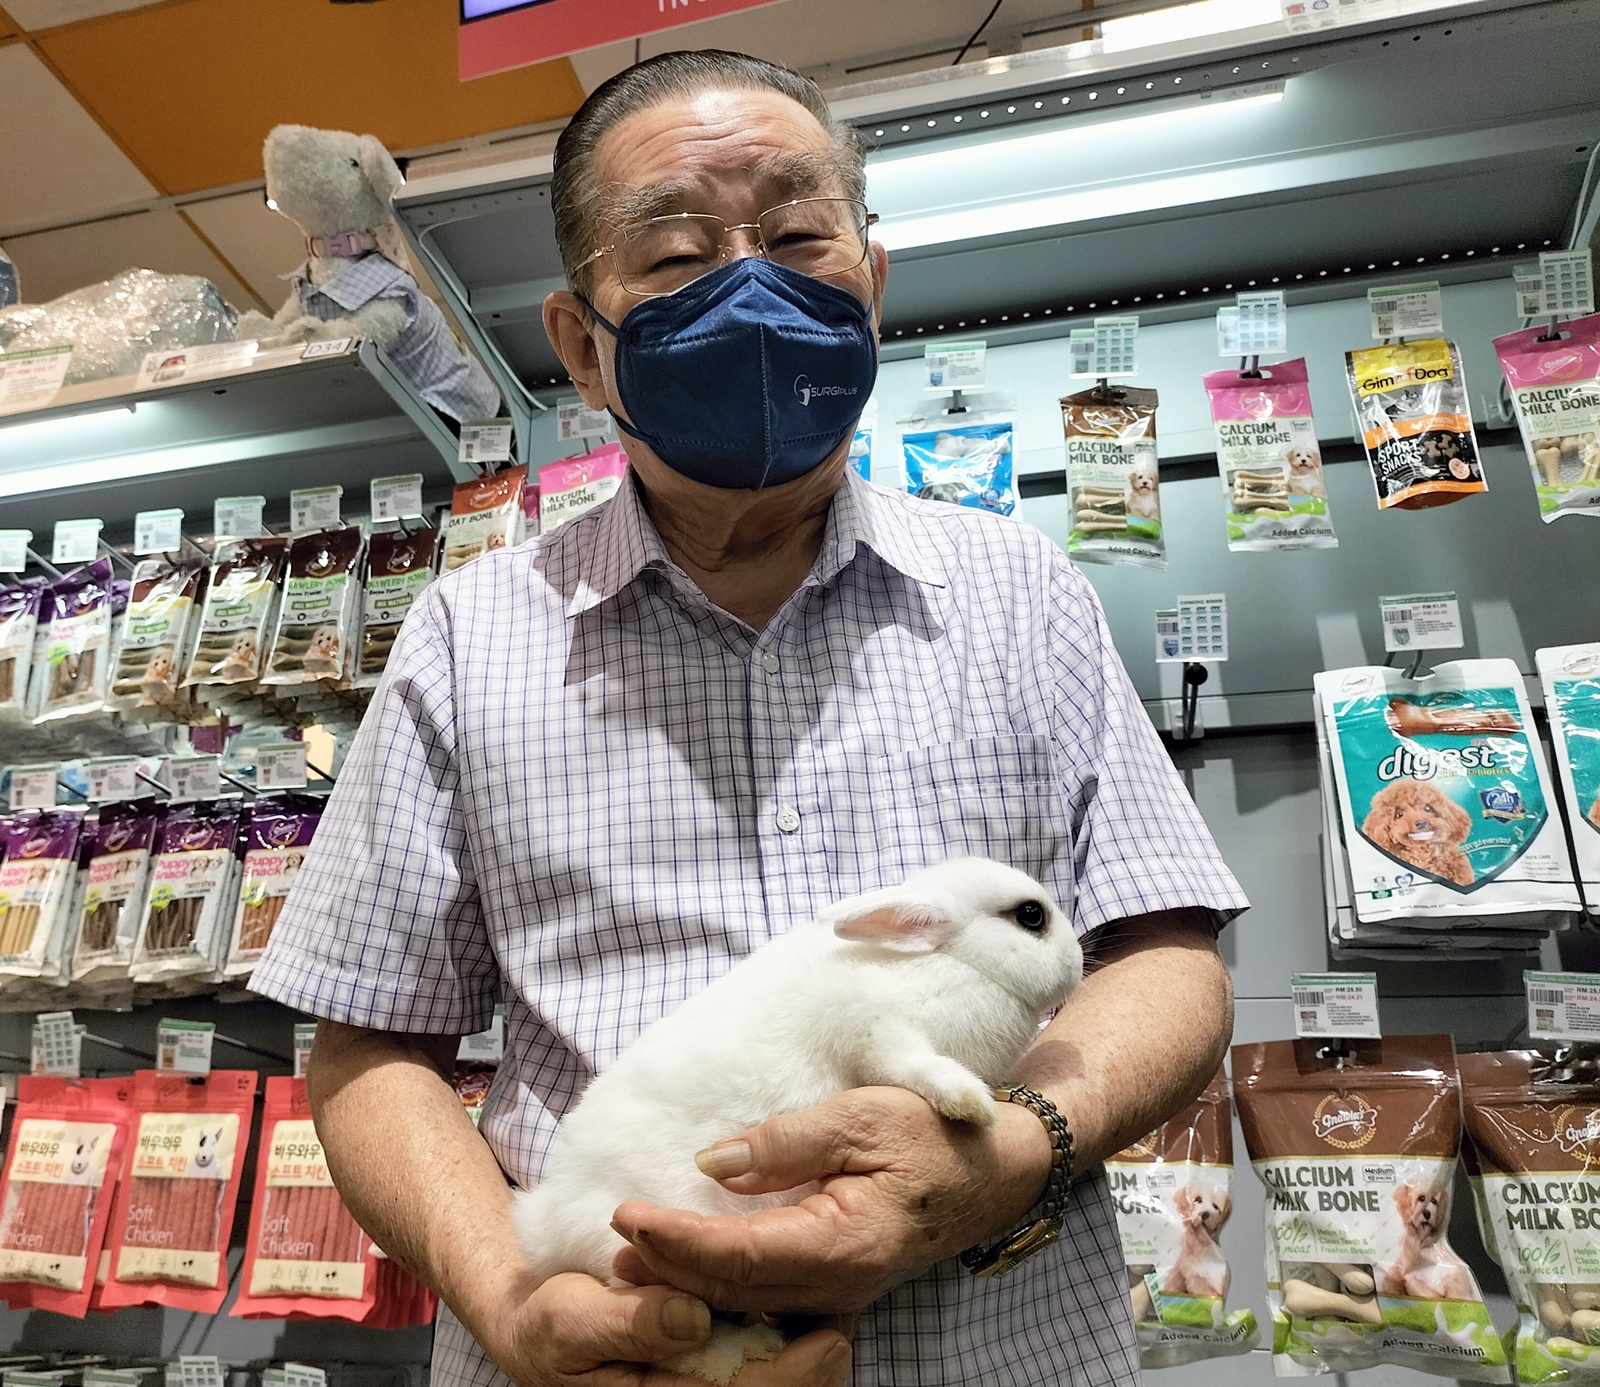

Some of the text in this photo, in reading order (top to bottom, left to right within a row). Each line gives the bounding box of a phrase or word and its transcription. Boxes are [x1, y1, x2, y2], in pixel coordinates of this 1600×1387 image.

[308, 342, 343, 356] D34
[1522, 394, 1600, 417] MILK BONE
[1219, 422, 1277, 436] CALCIUM
[1221, 432, 1291, 447] MILK BONE
[1068, 441, 1123, 453] CALCIUM
[1380, 438, 1419, 463] SPORT
[1069, 453, 1135, 465] MILK BONE
[1382, 451, 1422, 475] SNACKS
[570, 493, 596, 507] BONE
[449, 511, 493, 528] OAT BONE
[1272, 527, 1332, 537] Added Calcium
[1108, 545, 1161, 558] Added Calcium
[1378, 745, 1496, 780] digest
[1490, 792, 1515, 804] 24h
[158, 858, 192, 869] Puppy
[245, 856, 285, 866] Puppy
[1, 867, 27, 879] uppy
[275, 1143, 320, 1160] 바우와우
[1265, 1166, 1393, 1188] CALCIUM Medium
[1273, 1190, 1381, 1212] MILK BONE
[128, 1204, 153, 1222] Soft
[1506, 1208, 1564, 1230] MILK
[263, 1214, 290, 1234] Soft
[125, 1225, 174, 1245] Chicken
[261, 1236, 314, 1256] Chicken
[1321, 1246, 1376, 1255] Freshen Breath
[1573, 1248, 1597, 1256] Helps
[1429, 1343, 1486, 1357] Calcium
